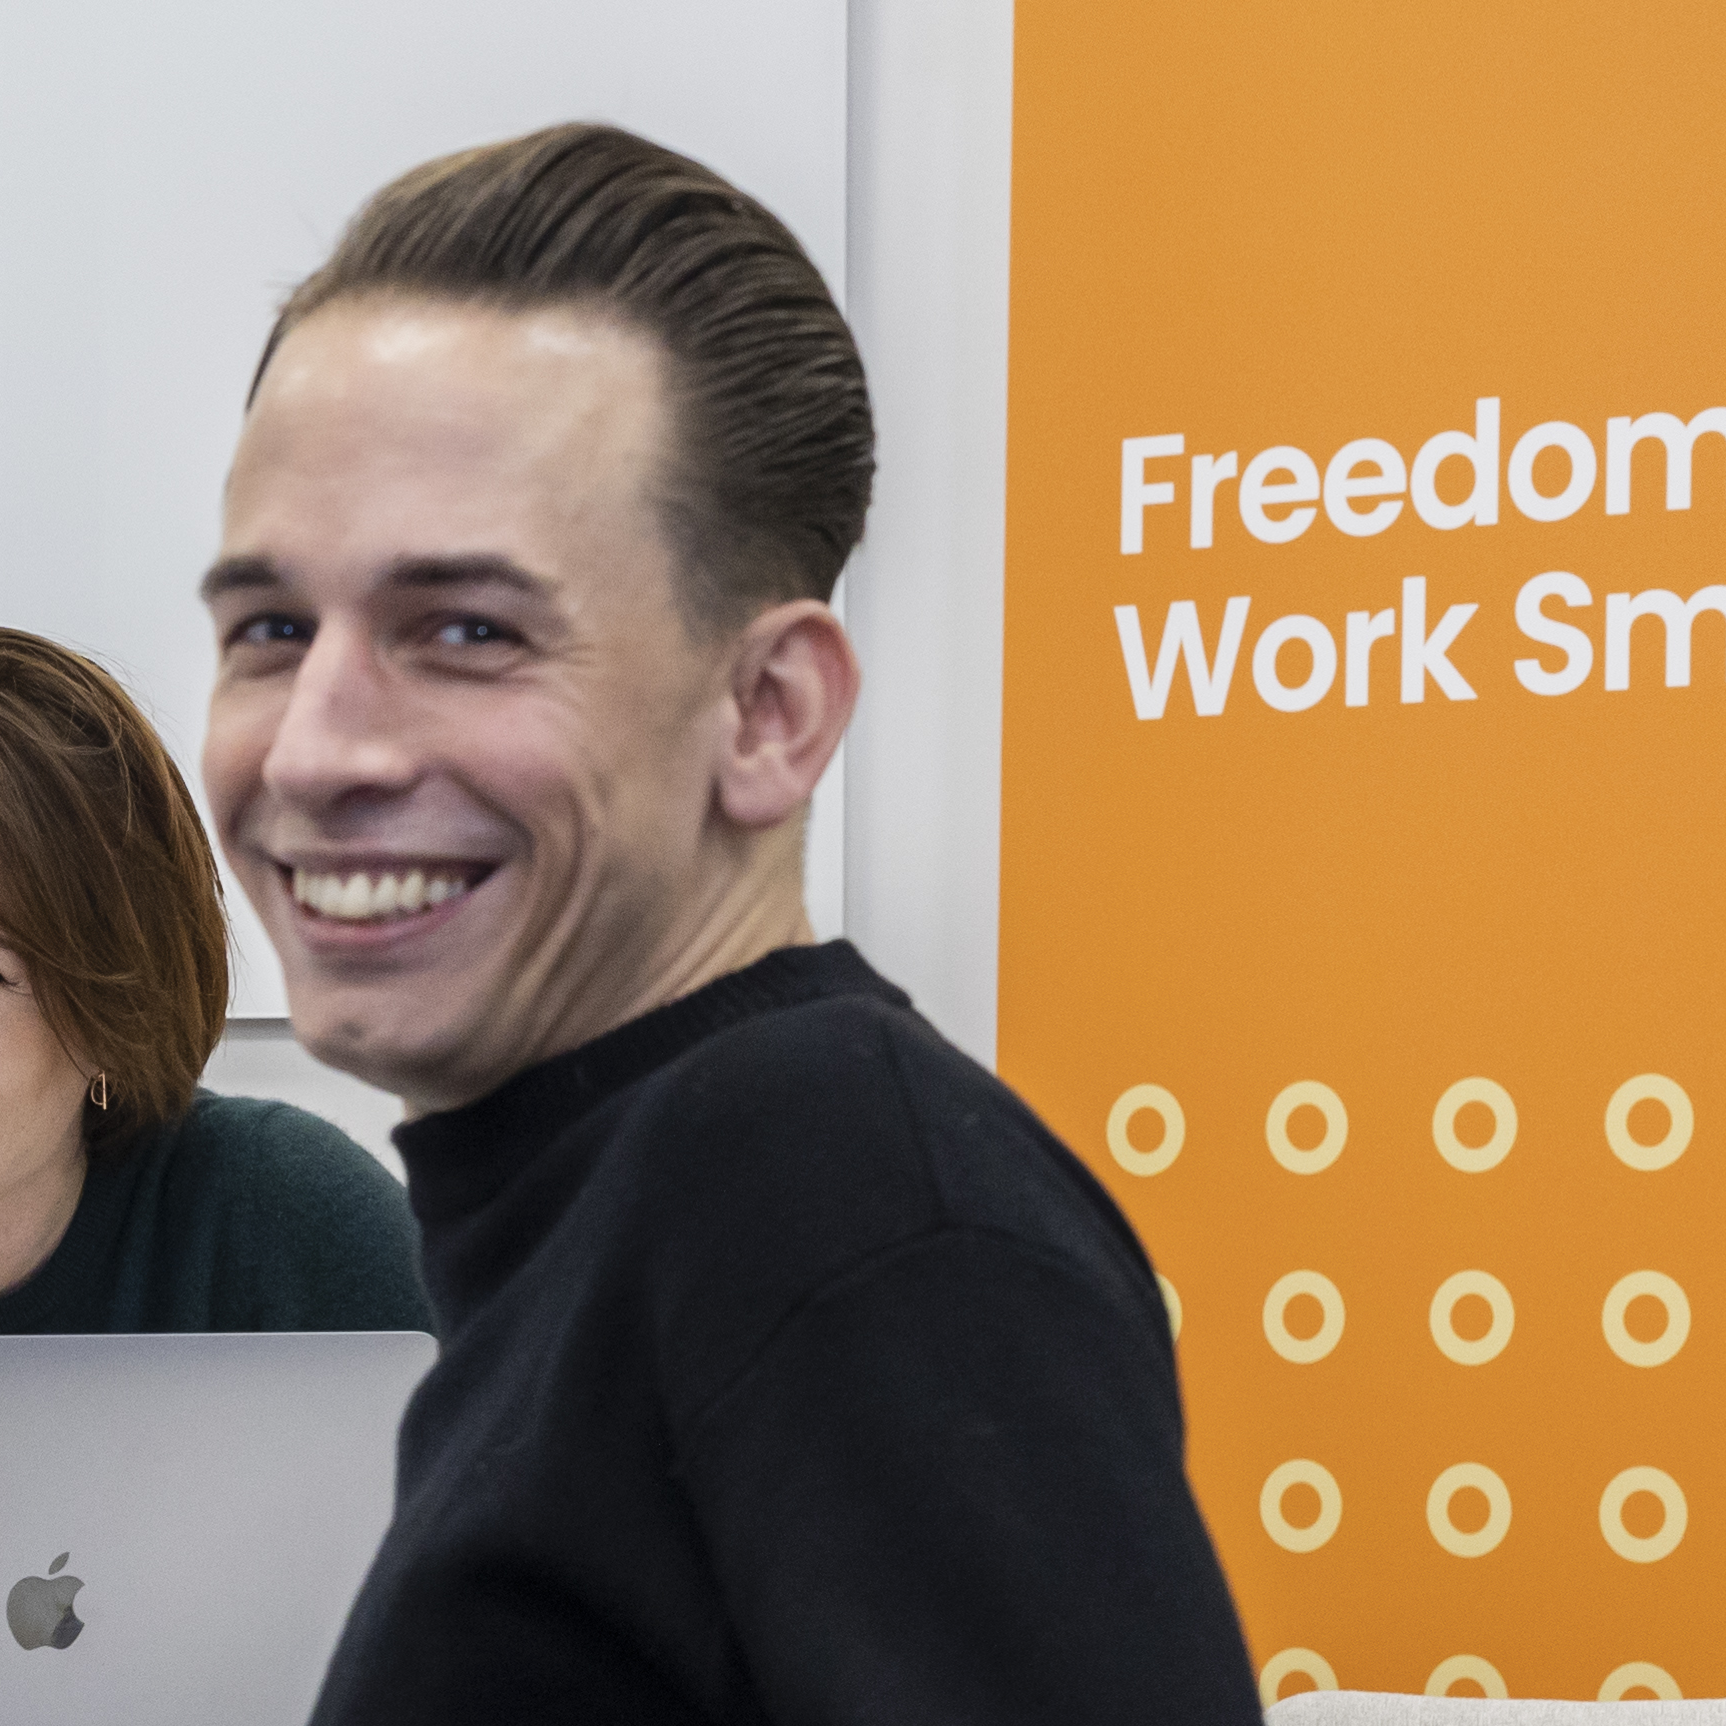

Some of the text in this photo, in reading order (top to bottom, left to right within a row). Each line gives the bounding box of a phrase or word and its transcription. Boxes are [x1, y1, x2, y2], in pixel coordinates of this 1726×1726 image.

[1119, 395, 1726, 556] Freedom
[1113, 570, 1726, 722] Work Sm
